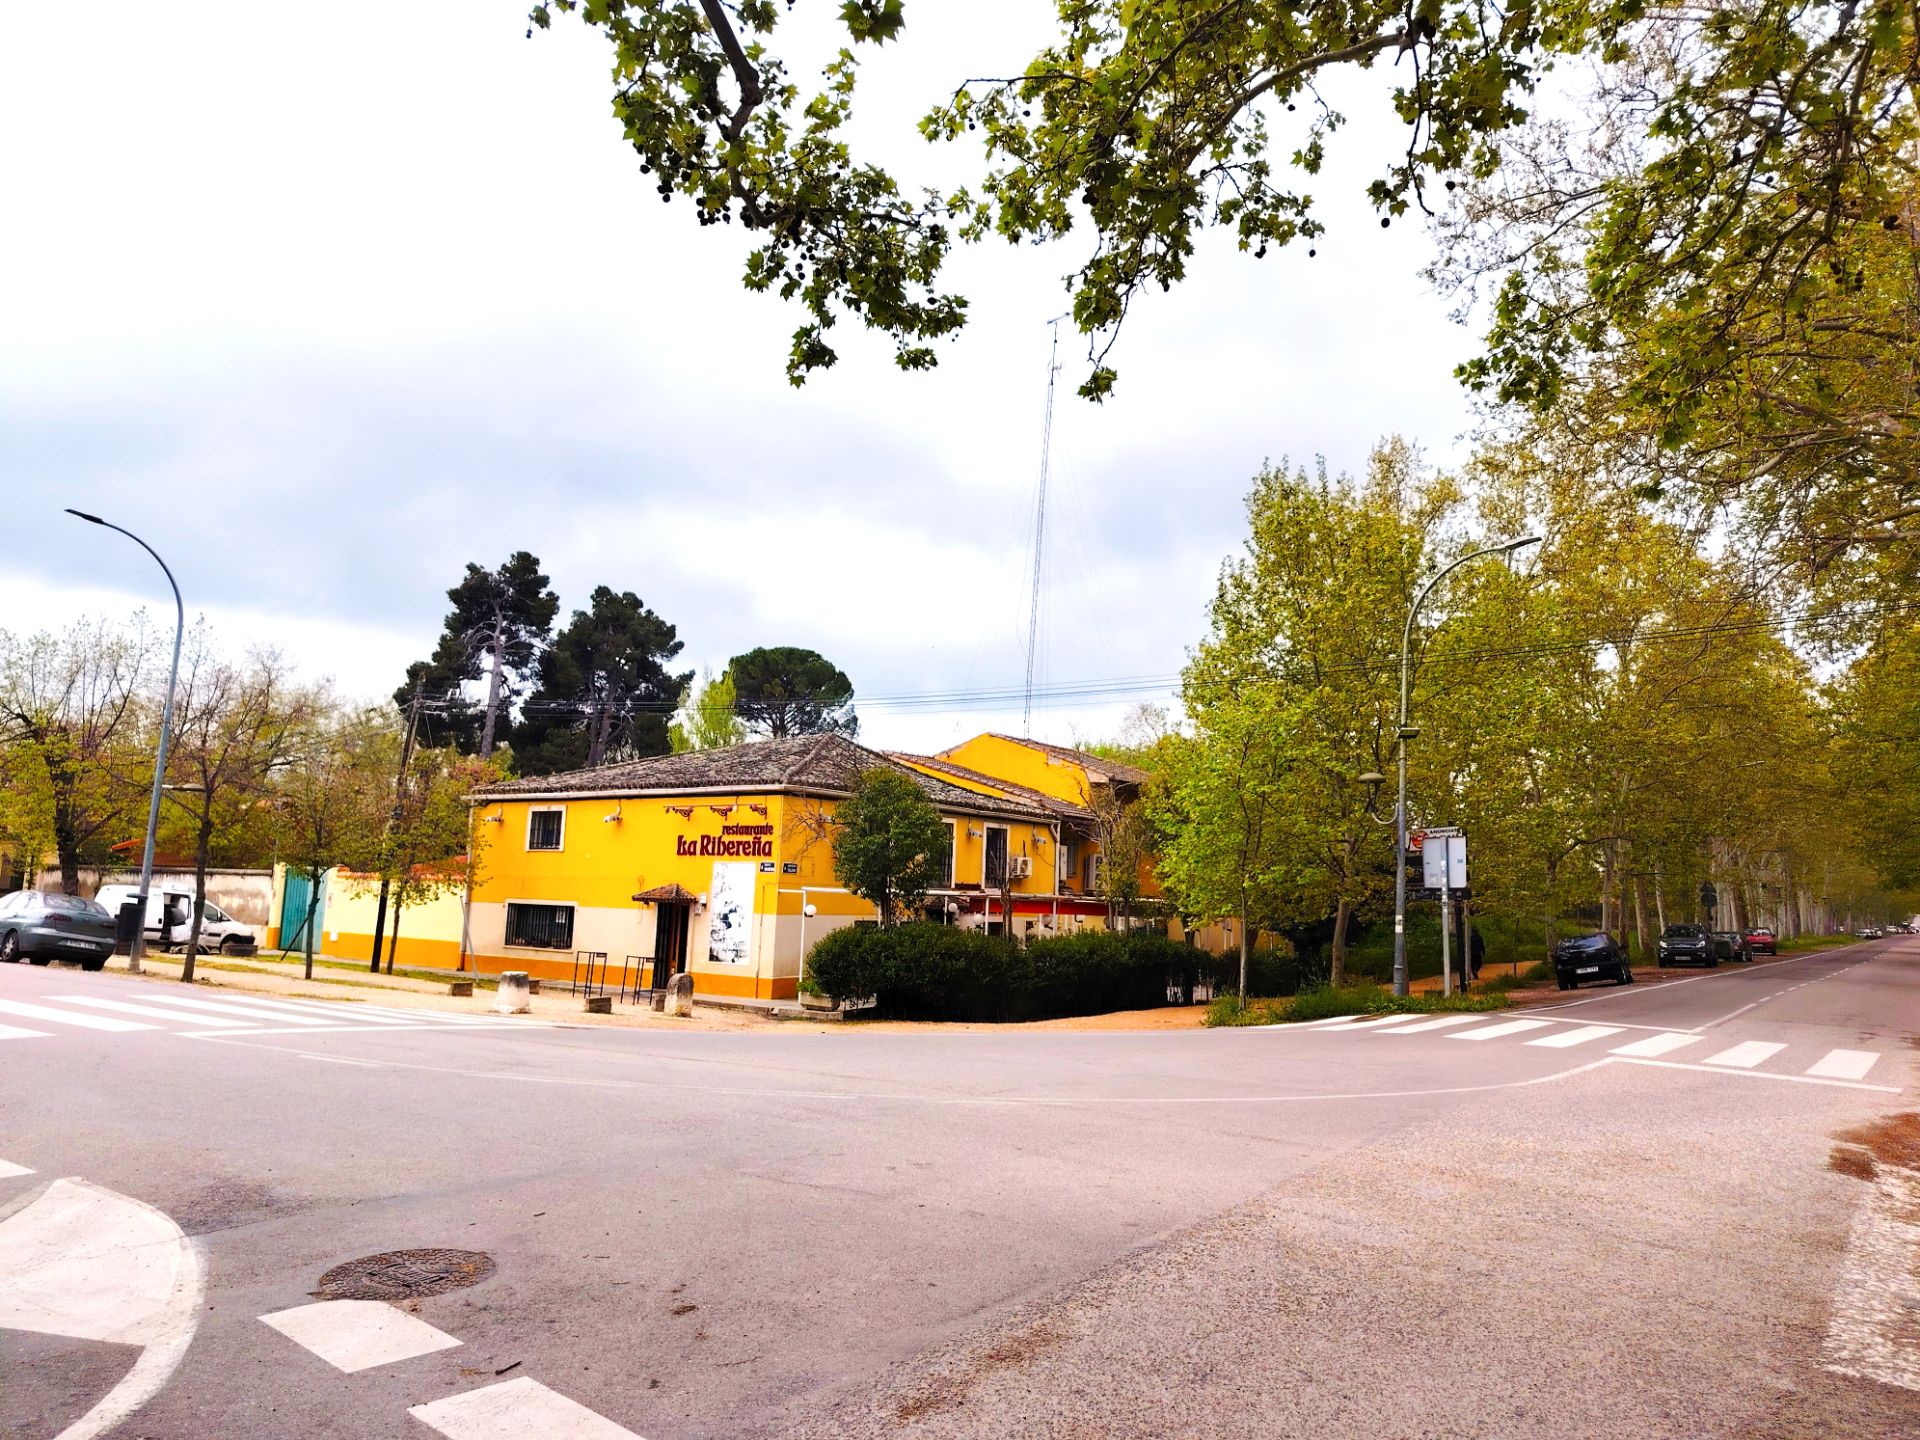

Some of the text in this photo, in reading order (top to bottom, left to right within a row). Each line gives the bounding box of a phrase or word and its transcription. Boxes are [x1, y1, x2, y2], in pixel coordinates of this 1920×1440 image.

[722, 822, 773, 835] restaurante
[677, 835, 772, 856] La Ribereña
